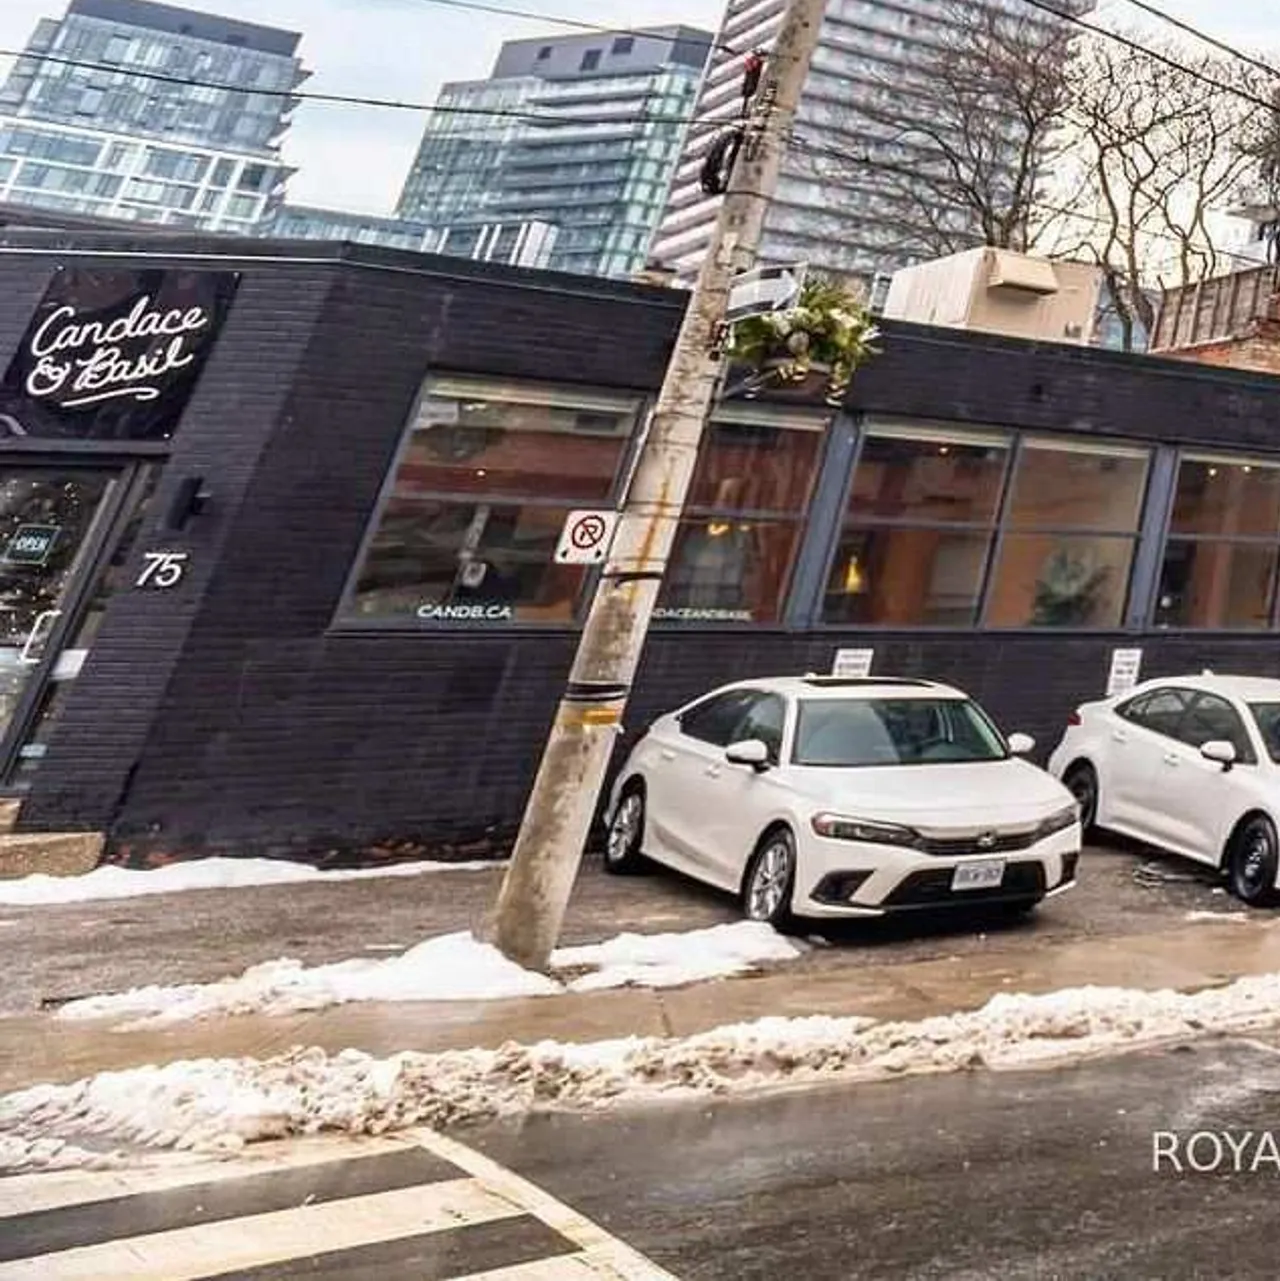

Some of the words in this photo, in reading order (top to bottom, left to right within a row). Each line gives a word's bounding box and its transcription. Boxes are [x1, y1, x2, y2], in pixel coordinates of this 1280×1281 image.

[31, 295, 208, 356] Candace
[26, 357, 72, 395] &
[72, 336, 194, 391] Basil
[136, 552, 188, 587] 75
